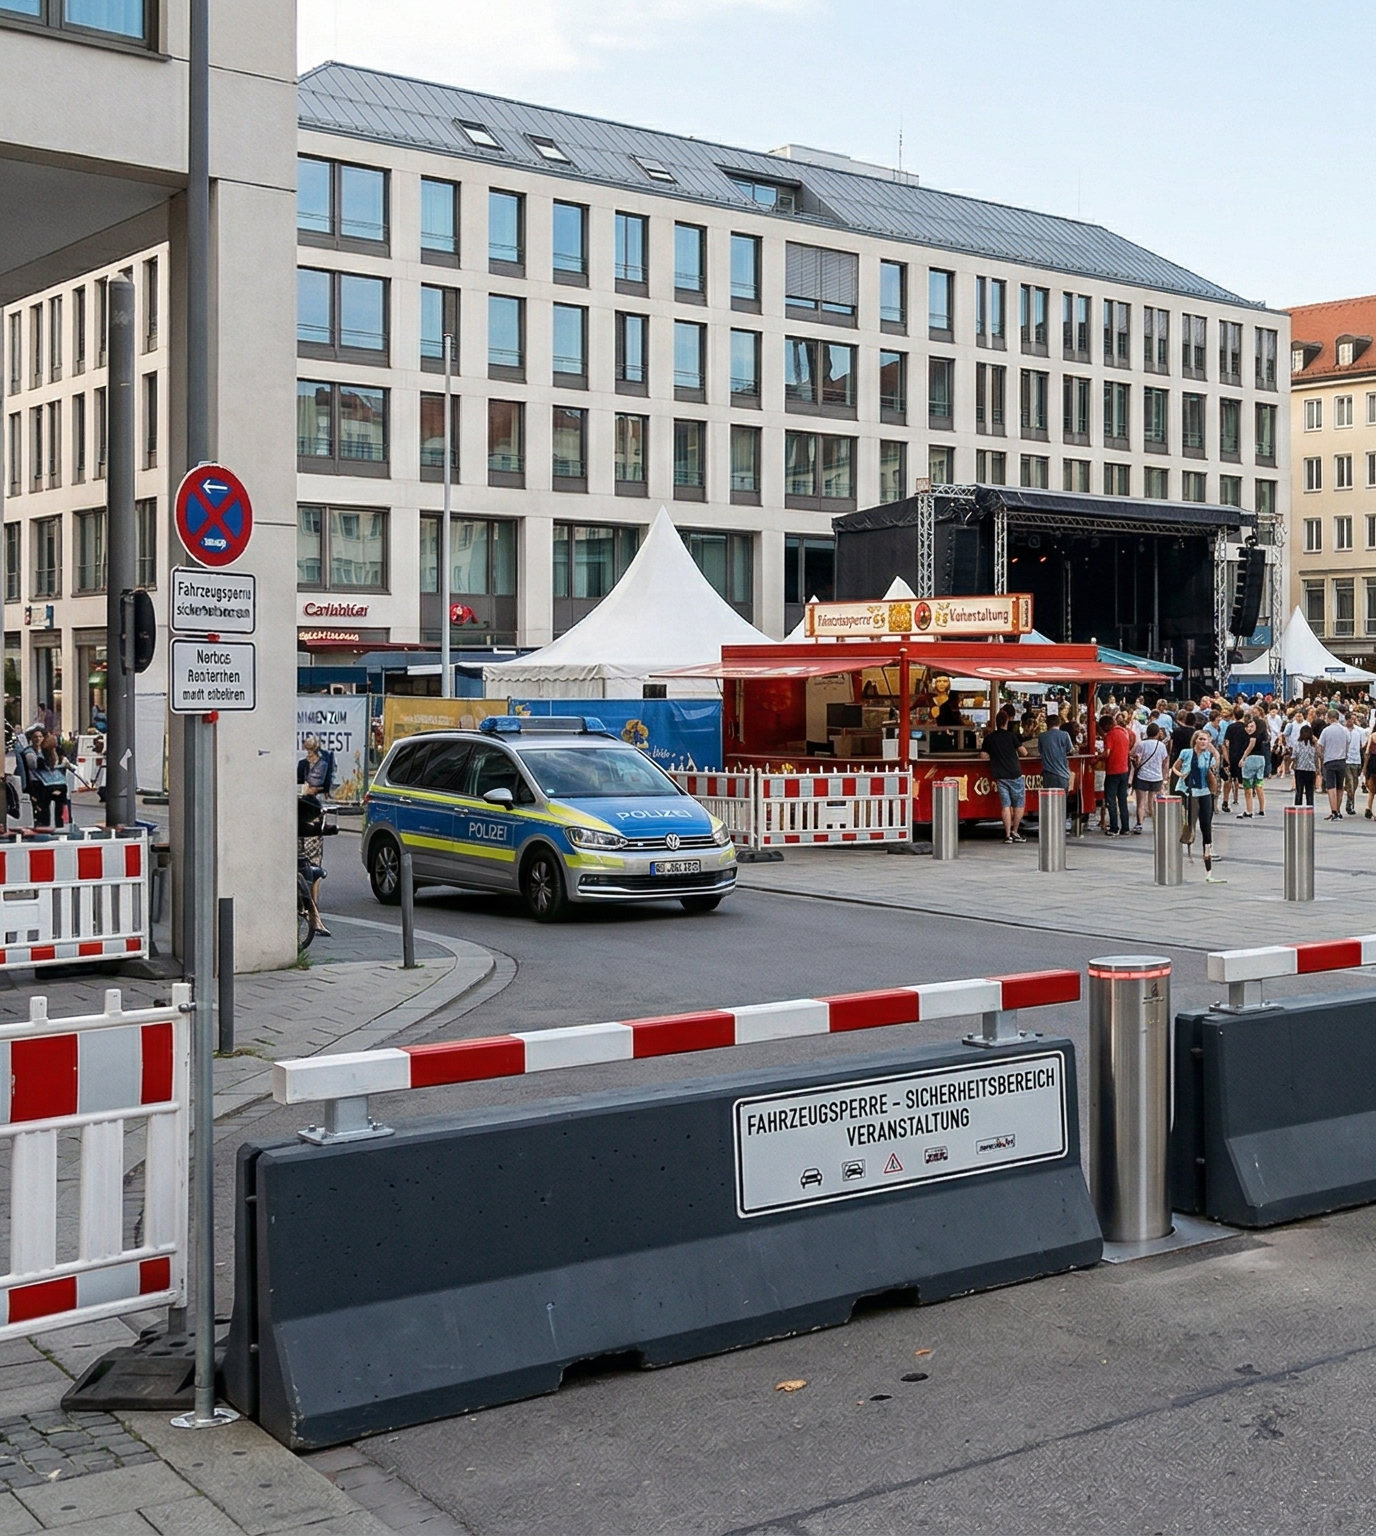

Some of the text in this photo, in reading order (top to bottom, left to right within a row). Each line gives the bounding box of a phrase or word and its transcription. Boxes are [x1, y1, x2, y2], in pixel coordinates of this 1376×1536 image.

[615, 809, 693, 821] POLIZEI
[747, 1093, 889, 1137] FAHRZEUGSPERRE
[905, 1067, 1056, 1110] SICHERHEITSBEREICH
[846, 1107, 970, 1147] VERANSTALTUNG
